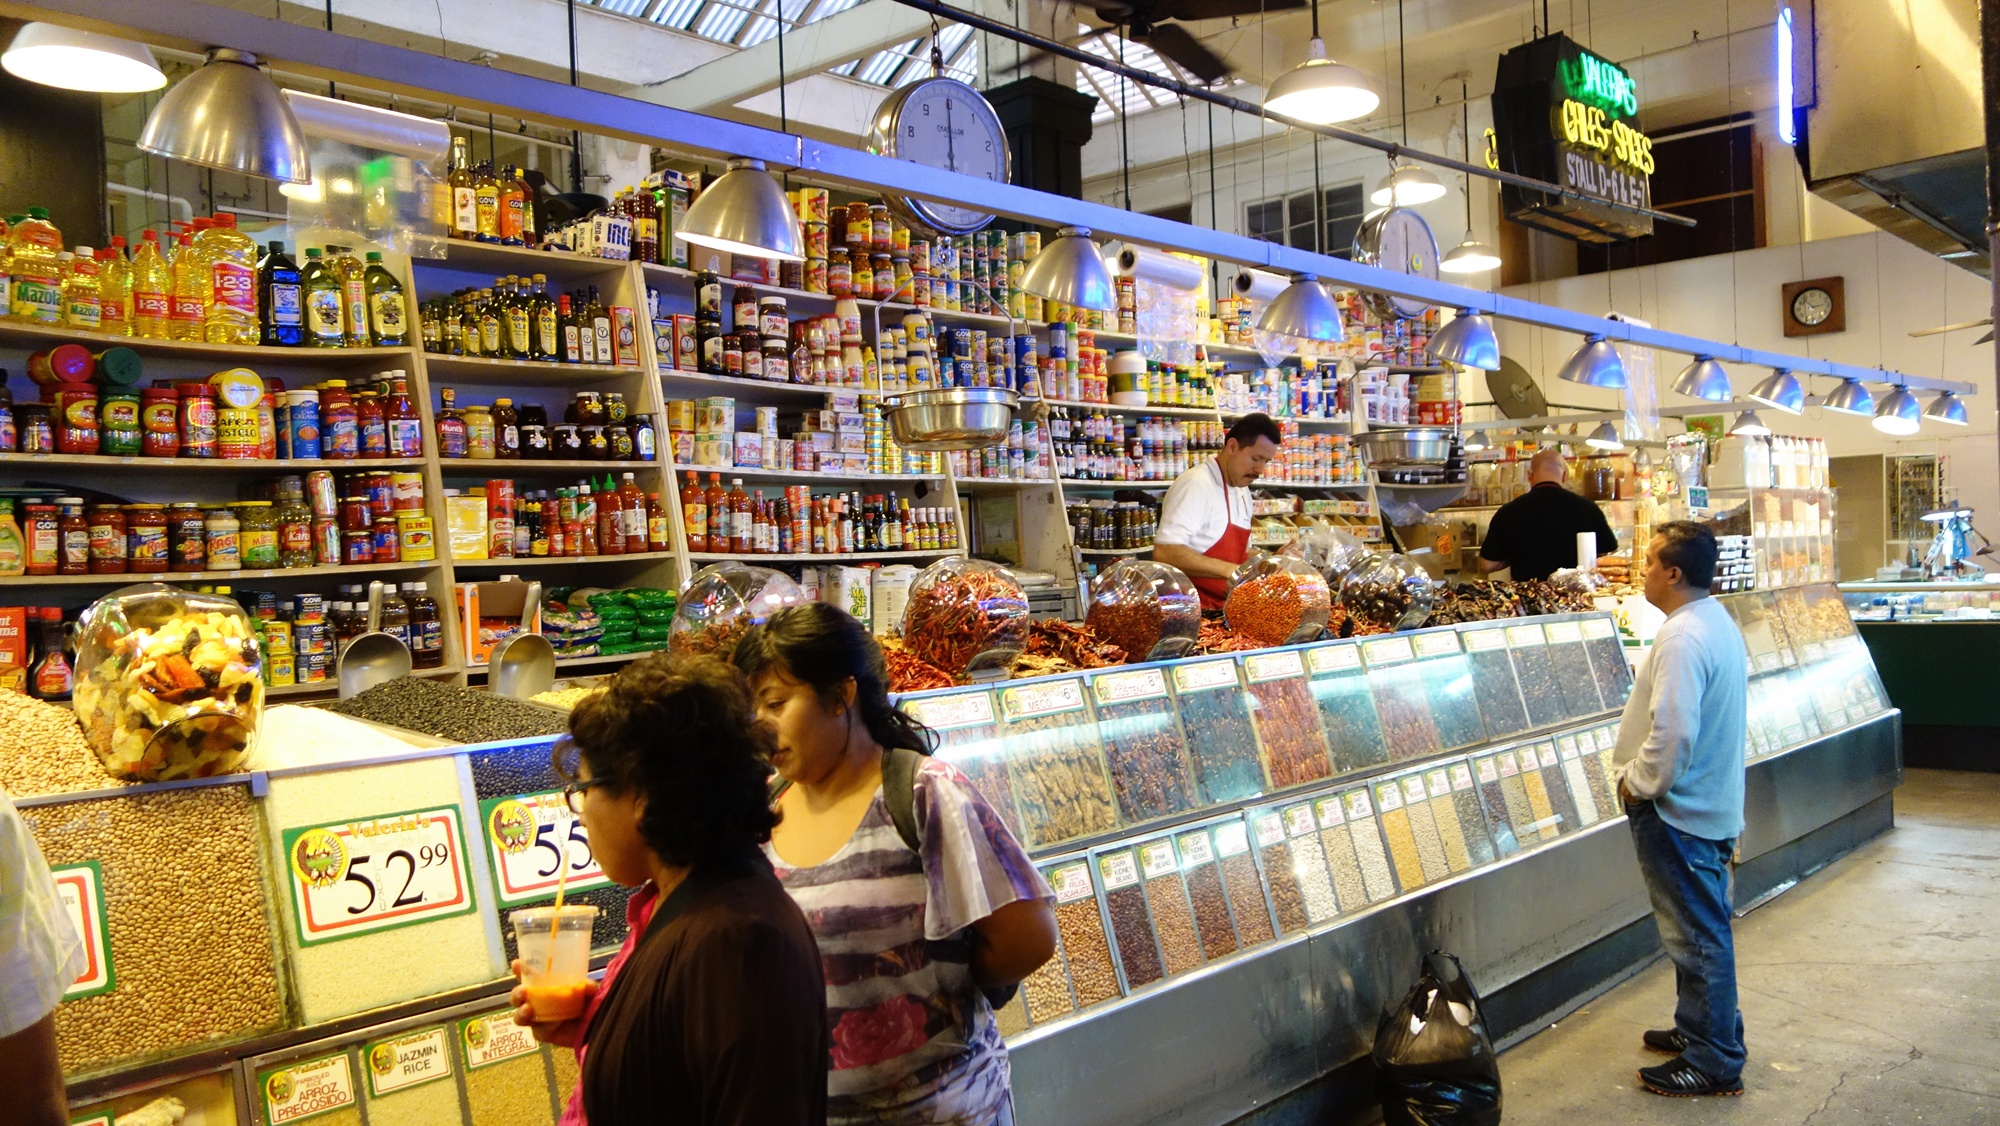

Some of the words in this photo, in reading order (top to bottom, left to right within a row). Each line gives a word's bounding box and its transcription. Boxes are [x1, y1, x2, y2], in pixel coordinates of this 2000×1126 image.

[923, 104, 930, 116] 9
[971, 113, 975, 124] 1
[908, 126, 915, 138] 8
[985, 140, 991, 152] 2
[1566, 152, 1597, 193] STALL
[1598, 164, 1618, 200] D-6
[1629, 175, 1646, 207] E-7
[17, 284, 62, 306] Mazola
[70, 304, 100, 317] Mazola
[441, 424, 463, 433] Hunt's
[288, 531, 310, 542] Karo
[1148, 675, 1155, 687] 8
[1028, 698, 1052, 711] MECO
[534, 823, 561, 877] 5
[1154, 853, 1167, 861] PINK
[1112, 860, 1127, 869] DARK
[1113, 865, 1134, 876] KIDNEY
[1154, 860, 1172, 870] BEANS
[344, 855, 376, 914] 5
[420, 842, 448, 869] 99
[1068, 879, 1087, 888] FRIJOL
[1116, 874, 1134, 883] BEANS
[1059, 885, 1091, 899] CACAHUATE
[489, 1031, 525, 1048] ARROZ
[396, 1044, 438, 1065] JAZMIN
[482, 1039, 533, 1060] INTEGRAL
[403, 1059, 431, 1076] RICE
[298, 1081, 337, 1102] ARROZ
[277, 1091, 347, 1120] PRECOSIDO
